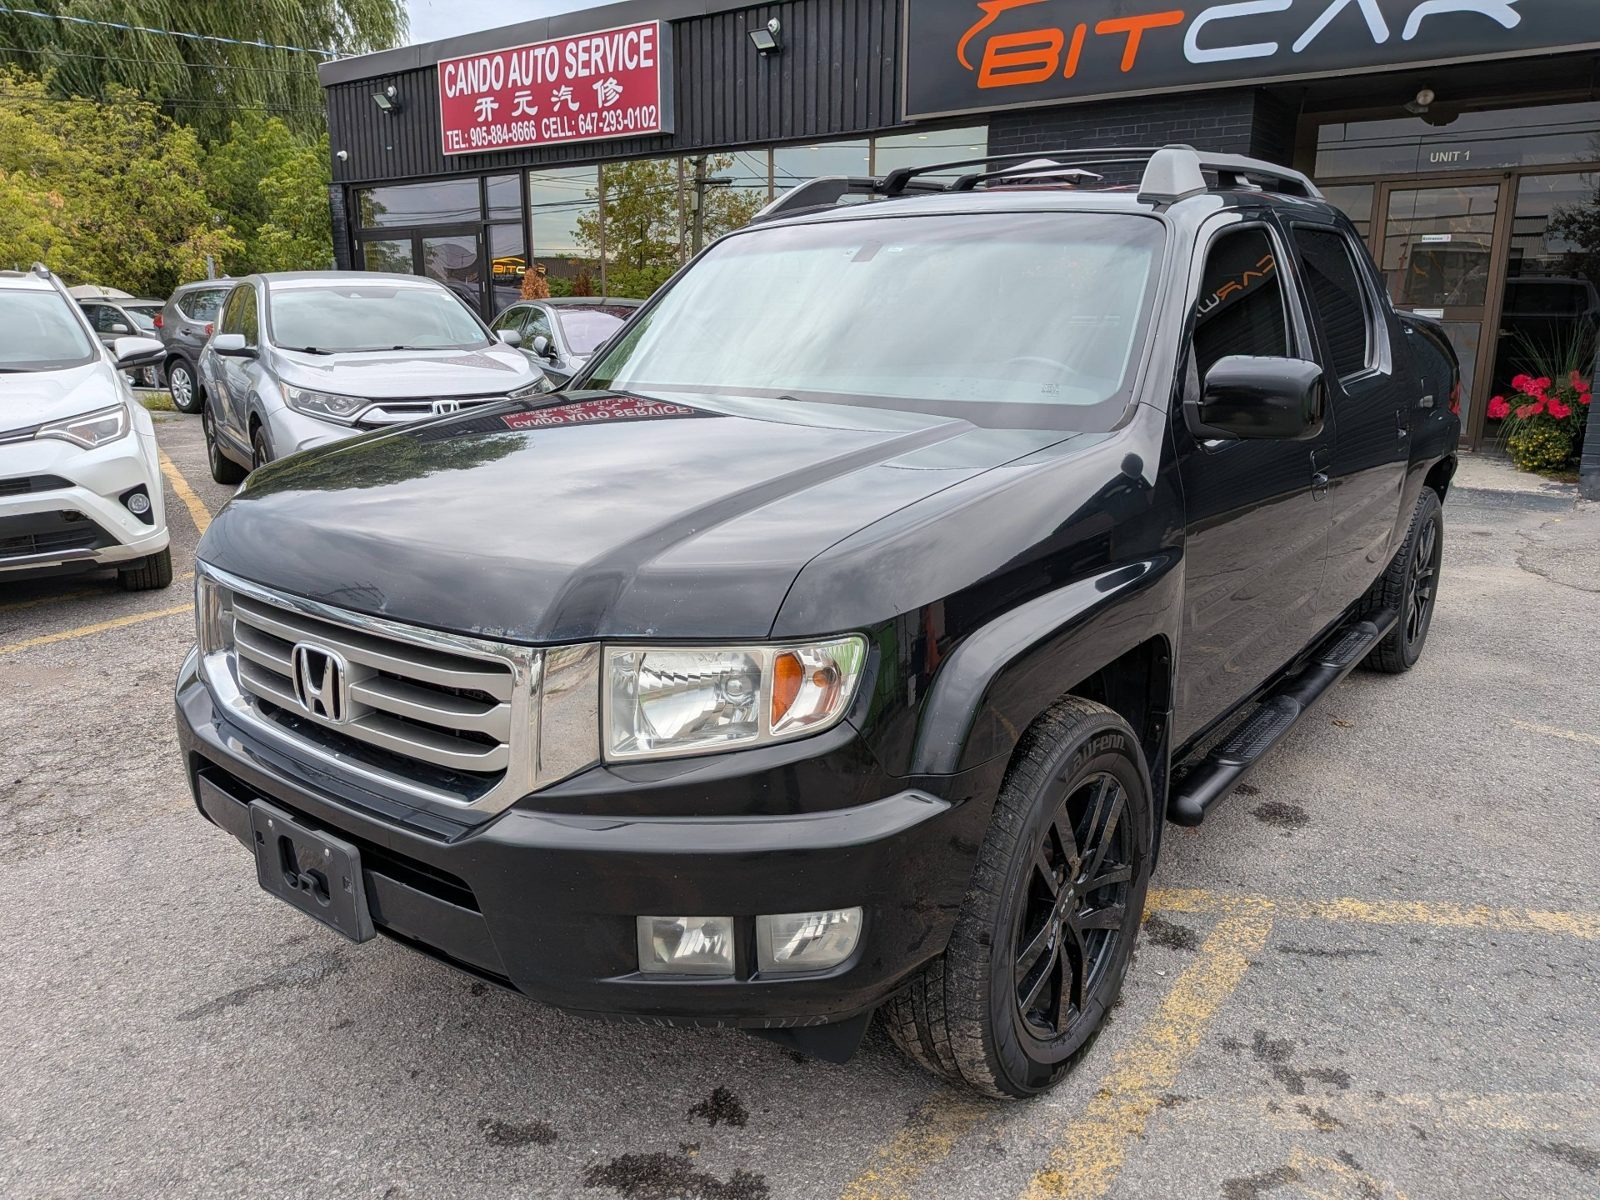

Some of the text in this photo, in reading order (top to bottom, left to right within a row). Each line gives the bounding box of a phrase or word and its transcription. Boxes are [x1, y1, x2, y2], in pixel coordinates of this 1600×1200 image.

[445, 28, 653, 98] CANDO AUTO SERVICE
[474, 77, 623, 122] 开元汽修
[446, 105, 657, 149] TEL: 905-884-8666 CELL: 647-293-0102
[1430, 150, 1471, 163] UNIT 1
